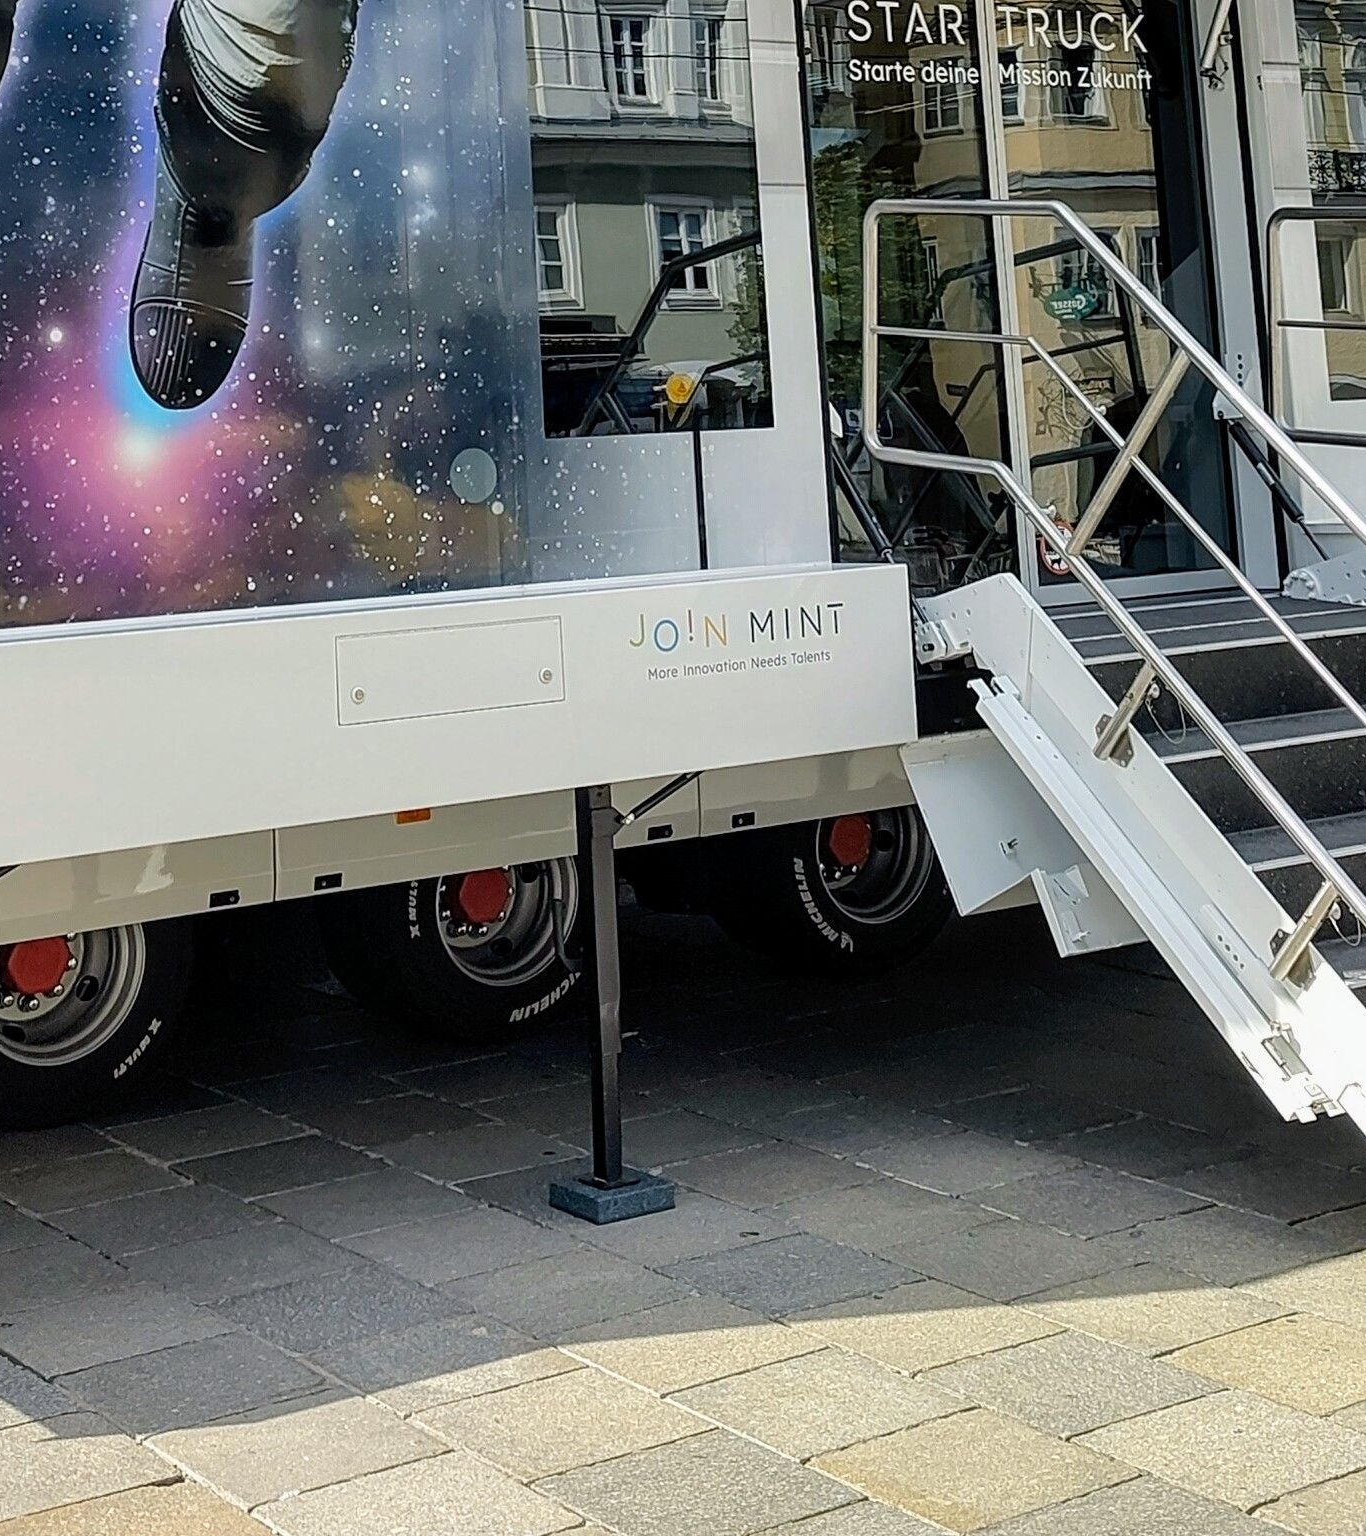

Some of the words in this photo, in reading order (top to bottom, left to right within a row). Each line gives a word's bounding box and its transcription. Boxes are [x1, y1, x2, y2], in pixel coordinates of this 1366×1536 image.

[846, 0, 966, 46] STAR
[996, 5, 1149, 54] TRUCK
[848, 58, 916, 83] Starte
[921, 61, 980, 84] deine
[999, 63, 1072, 87] Mission
[1077, 66, 1153, 91] Zukunft
[750, 603, 843, 643] MINT
[648, 666, 679, 681] More
[683, 659, 747, 677] Innovation
[751, 654, 788, 670] Needs
[791, 649, 831, 665] Talents
[408, 880, 420, 922] MULT
[793, 857, 839, 942] MICHELIN
[113, 1035, 152, 1080] MULTI
